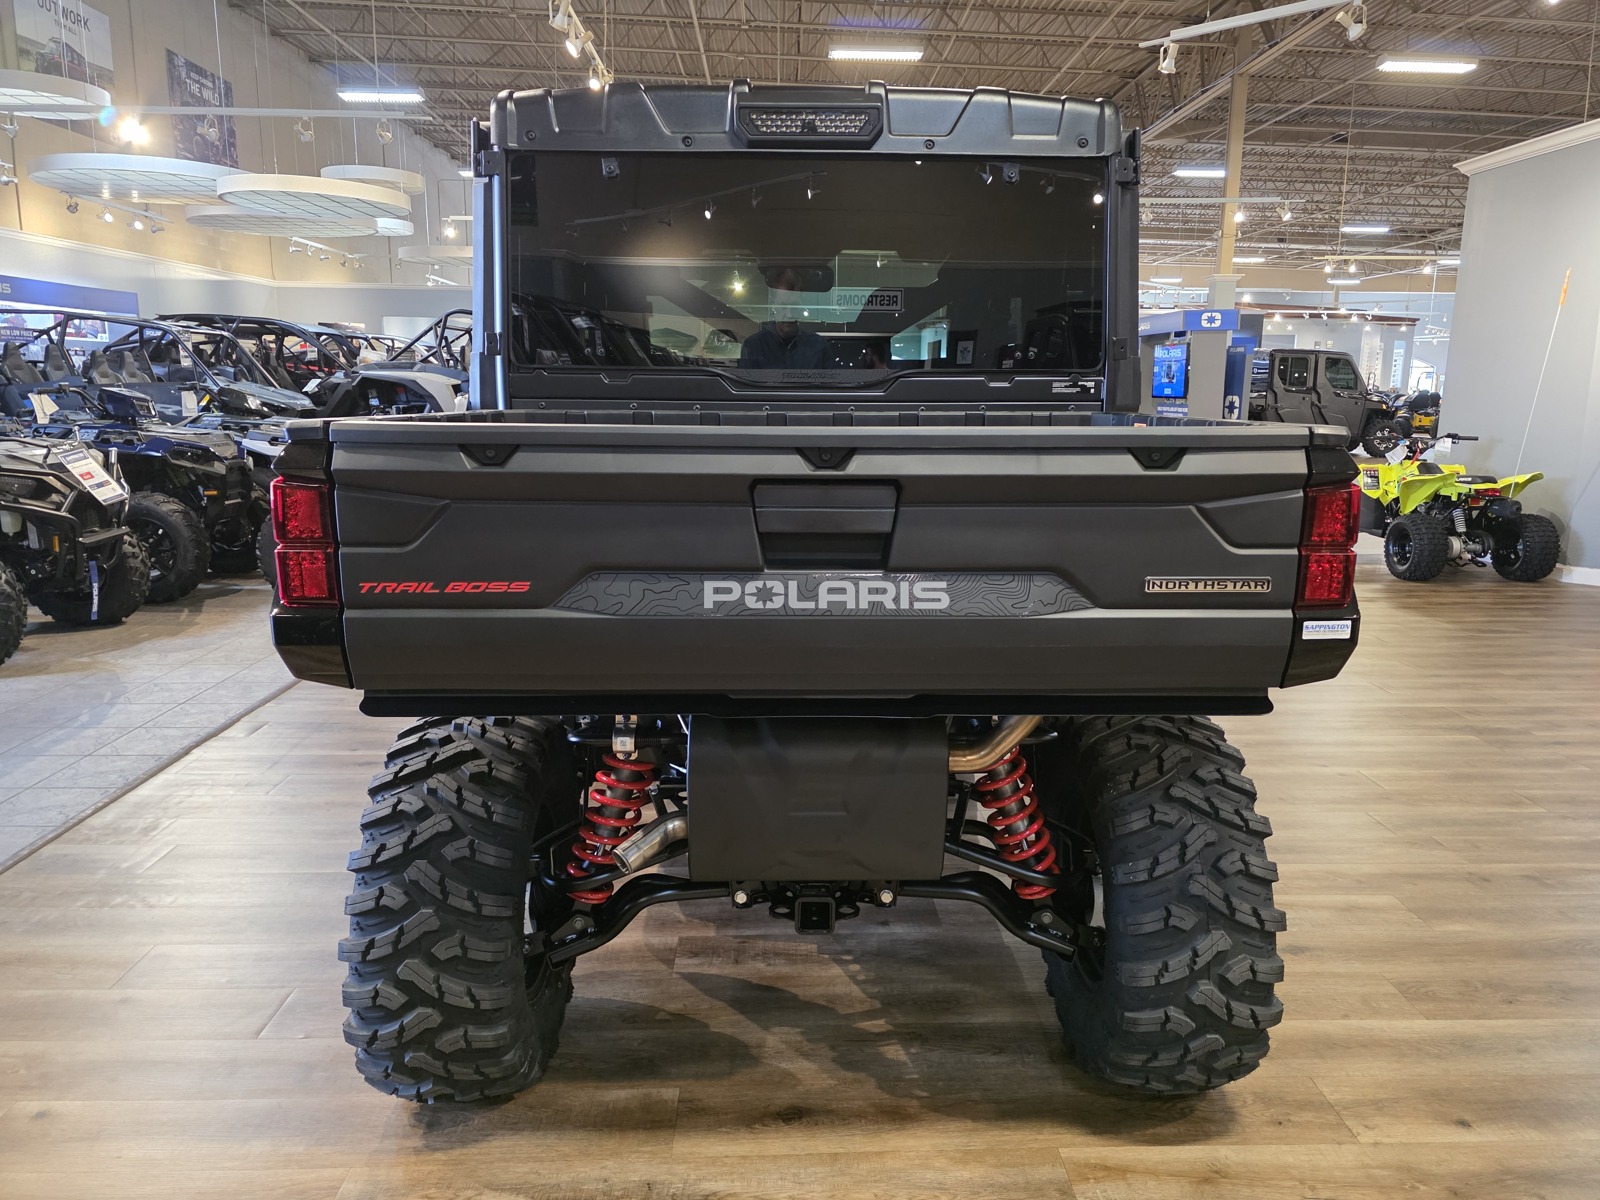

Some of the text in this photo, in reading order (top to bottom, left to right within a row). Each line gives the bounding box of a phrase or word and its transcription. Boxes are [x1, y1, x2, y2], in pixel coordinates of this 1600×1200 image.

[185, 78, 220, 106] THE WILD
[1160, 348, 1182, 358] POLARIS
[359, 581, 531, 593] TRAIL BOSS
[1151, 580, 1266, 590] NORTHSTAR
[703, 580, 950, 609] POLARIS
